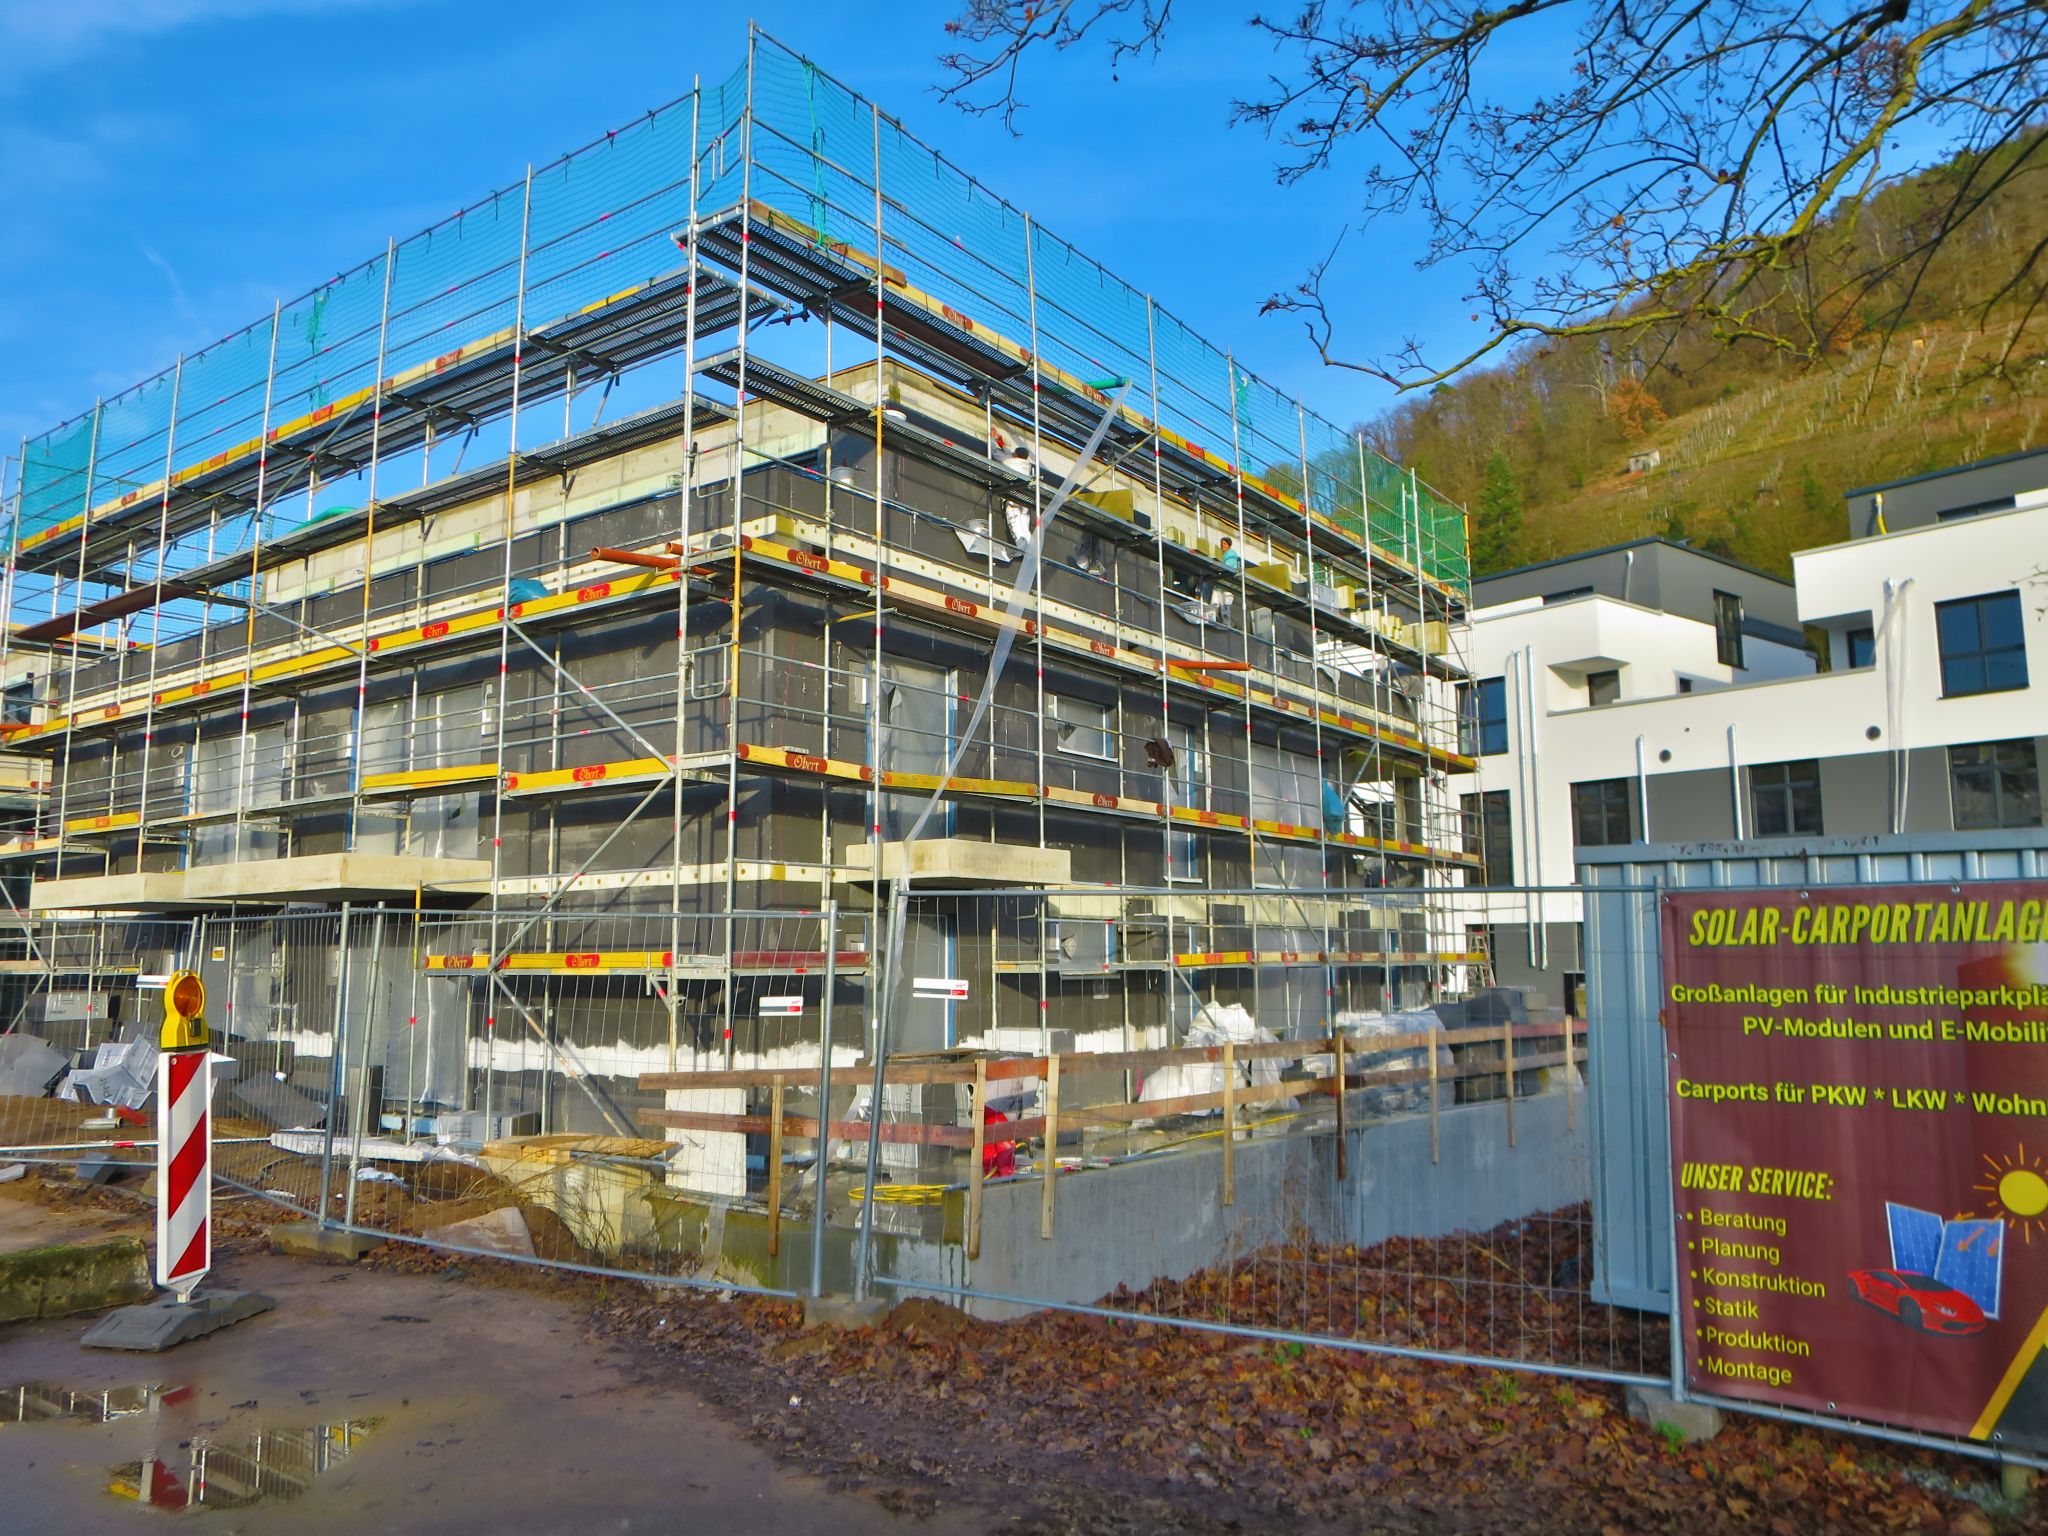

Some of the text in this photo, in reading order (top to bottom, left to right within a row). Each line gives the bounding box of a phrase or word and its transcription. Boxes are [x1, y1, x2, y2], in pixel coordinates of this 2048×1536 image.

[796, 551, 820, 569] Obert
[951, 598, 971, 614] Obert
[794, 755, 819, 771] Obert
[1671, 984, 1809, 1007] Großanlagen
[1814, 984, 1848, 1004] für
[1744, 1016, 2048, 1043] PV-Modulen und E-Mobili
[1676, 1079, 1769, 1103] Carports
[1775, 1082, 1805, 1102] für
[1812, 1085, 1867, 1106] PKW
[1892, 1089, 1947, 1110] LKW
[1681, 1163, 1835, 1200] UNSER SERVICE:
[1701, 1208, 1787, 1236] Beratung
[1702, 1238, 1780, 1265] Planung
[1704, 1268, 1826, 1298] Konstruktion
[1706, 1297, 1759, 1319] Statik
[1707, 1327, 1810, 1357] Produktion
[1708, 1356, 1792, 1386] Montage
